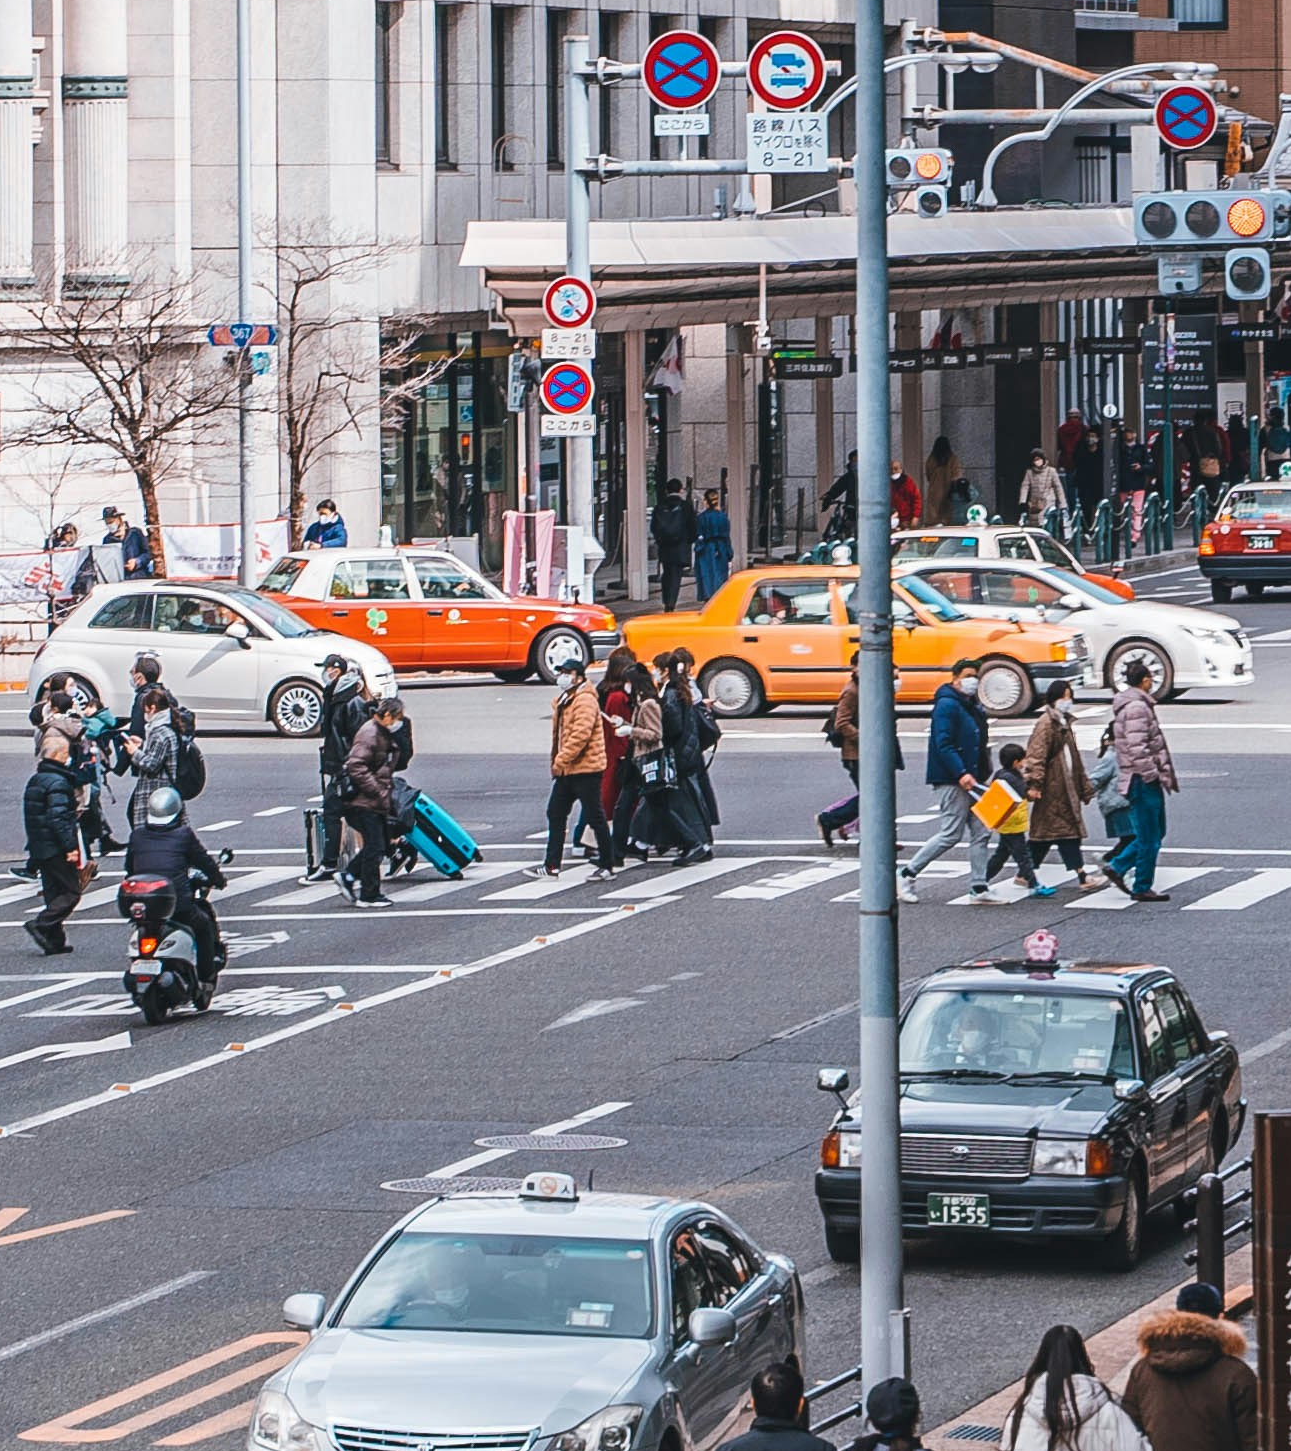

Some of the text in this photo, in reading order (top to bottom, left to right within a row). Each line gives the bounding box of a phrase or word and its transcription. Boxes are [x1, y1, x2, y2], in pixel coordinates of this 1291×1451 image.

[659, 119, 705, 130] ここから
[752, 118, 823, 132] 路線バス
[752, 135, 823, 148] マイクロを除く
[545, 345, 592, 355] ここから
[545, 420, 592, 431] ここから
[943, 1205, 987, 1224] 15-55
